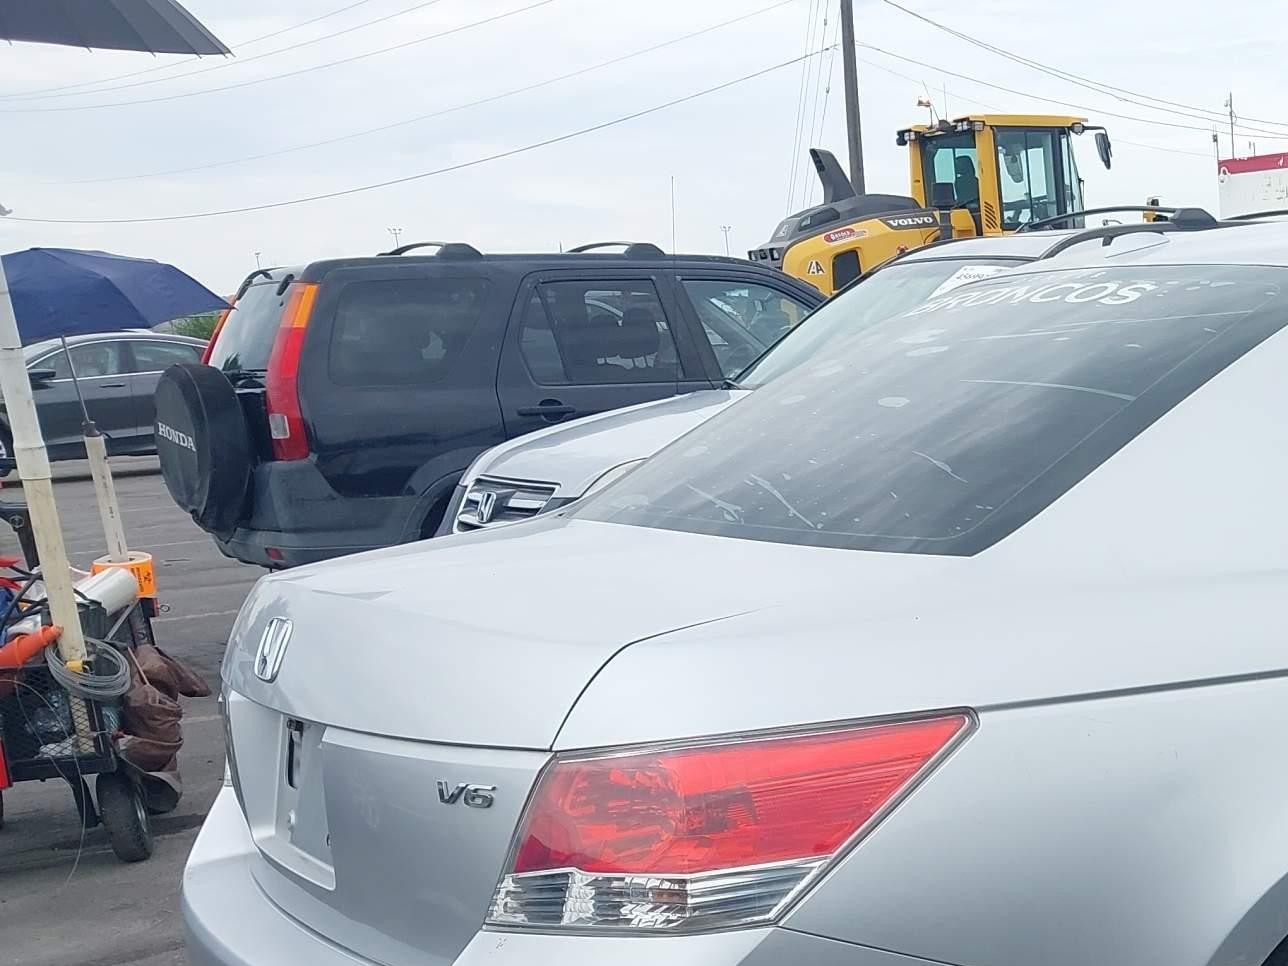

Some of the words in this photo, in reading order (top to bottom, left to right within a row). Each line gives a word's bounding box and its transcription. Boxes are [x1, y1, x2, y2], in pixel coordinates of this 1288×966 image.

[887, 215, 934, 227] VOLVO
[158, 422, 197, 452] HONDA
[436, 780, 498, 809] V6
